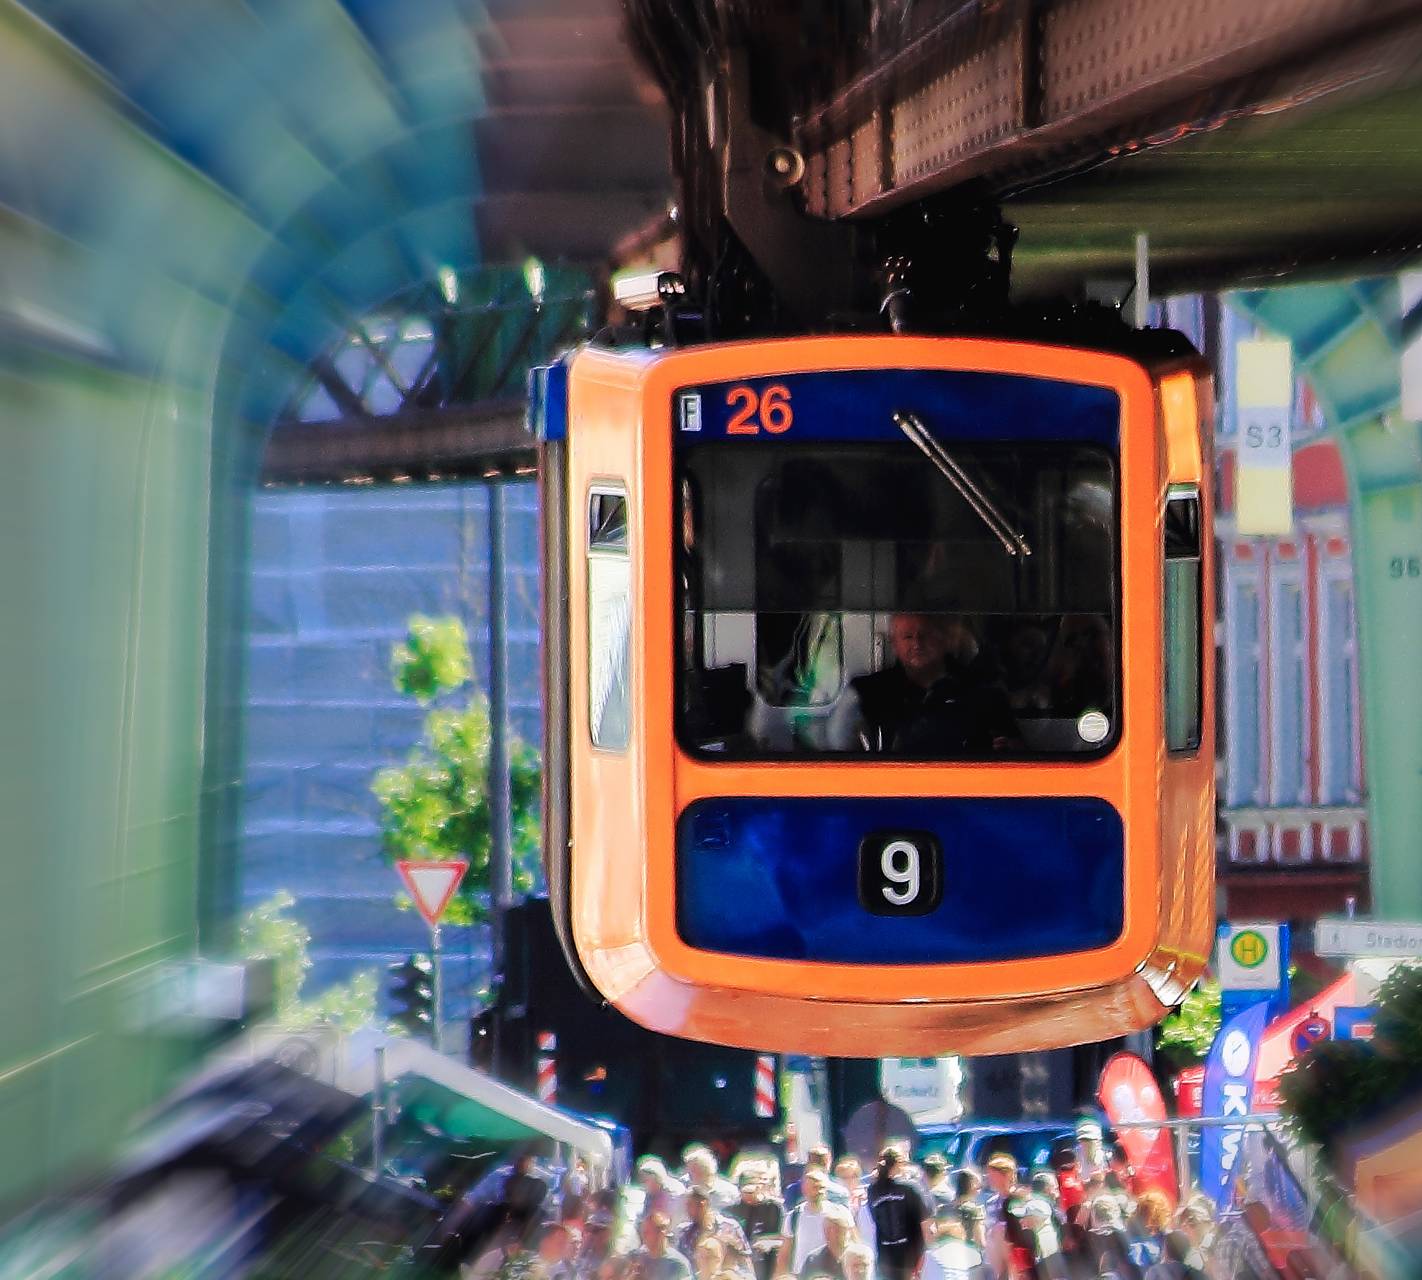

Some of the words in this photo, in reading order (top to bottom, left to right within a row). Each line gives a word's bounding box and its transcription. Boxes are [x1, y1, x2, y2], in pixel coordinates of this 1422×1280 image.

[726, 385, 794, 435] 26
[1247, 424, 1282, 449] S3
[1390, 556, 1421, 579] 96
[880, 840, 921, 906] 9
[1241, 939, 1257, 961] H
